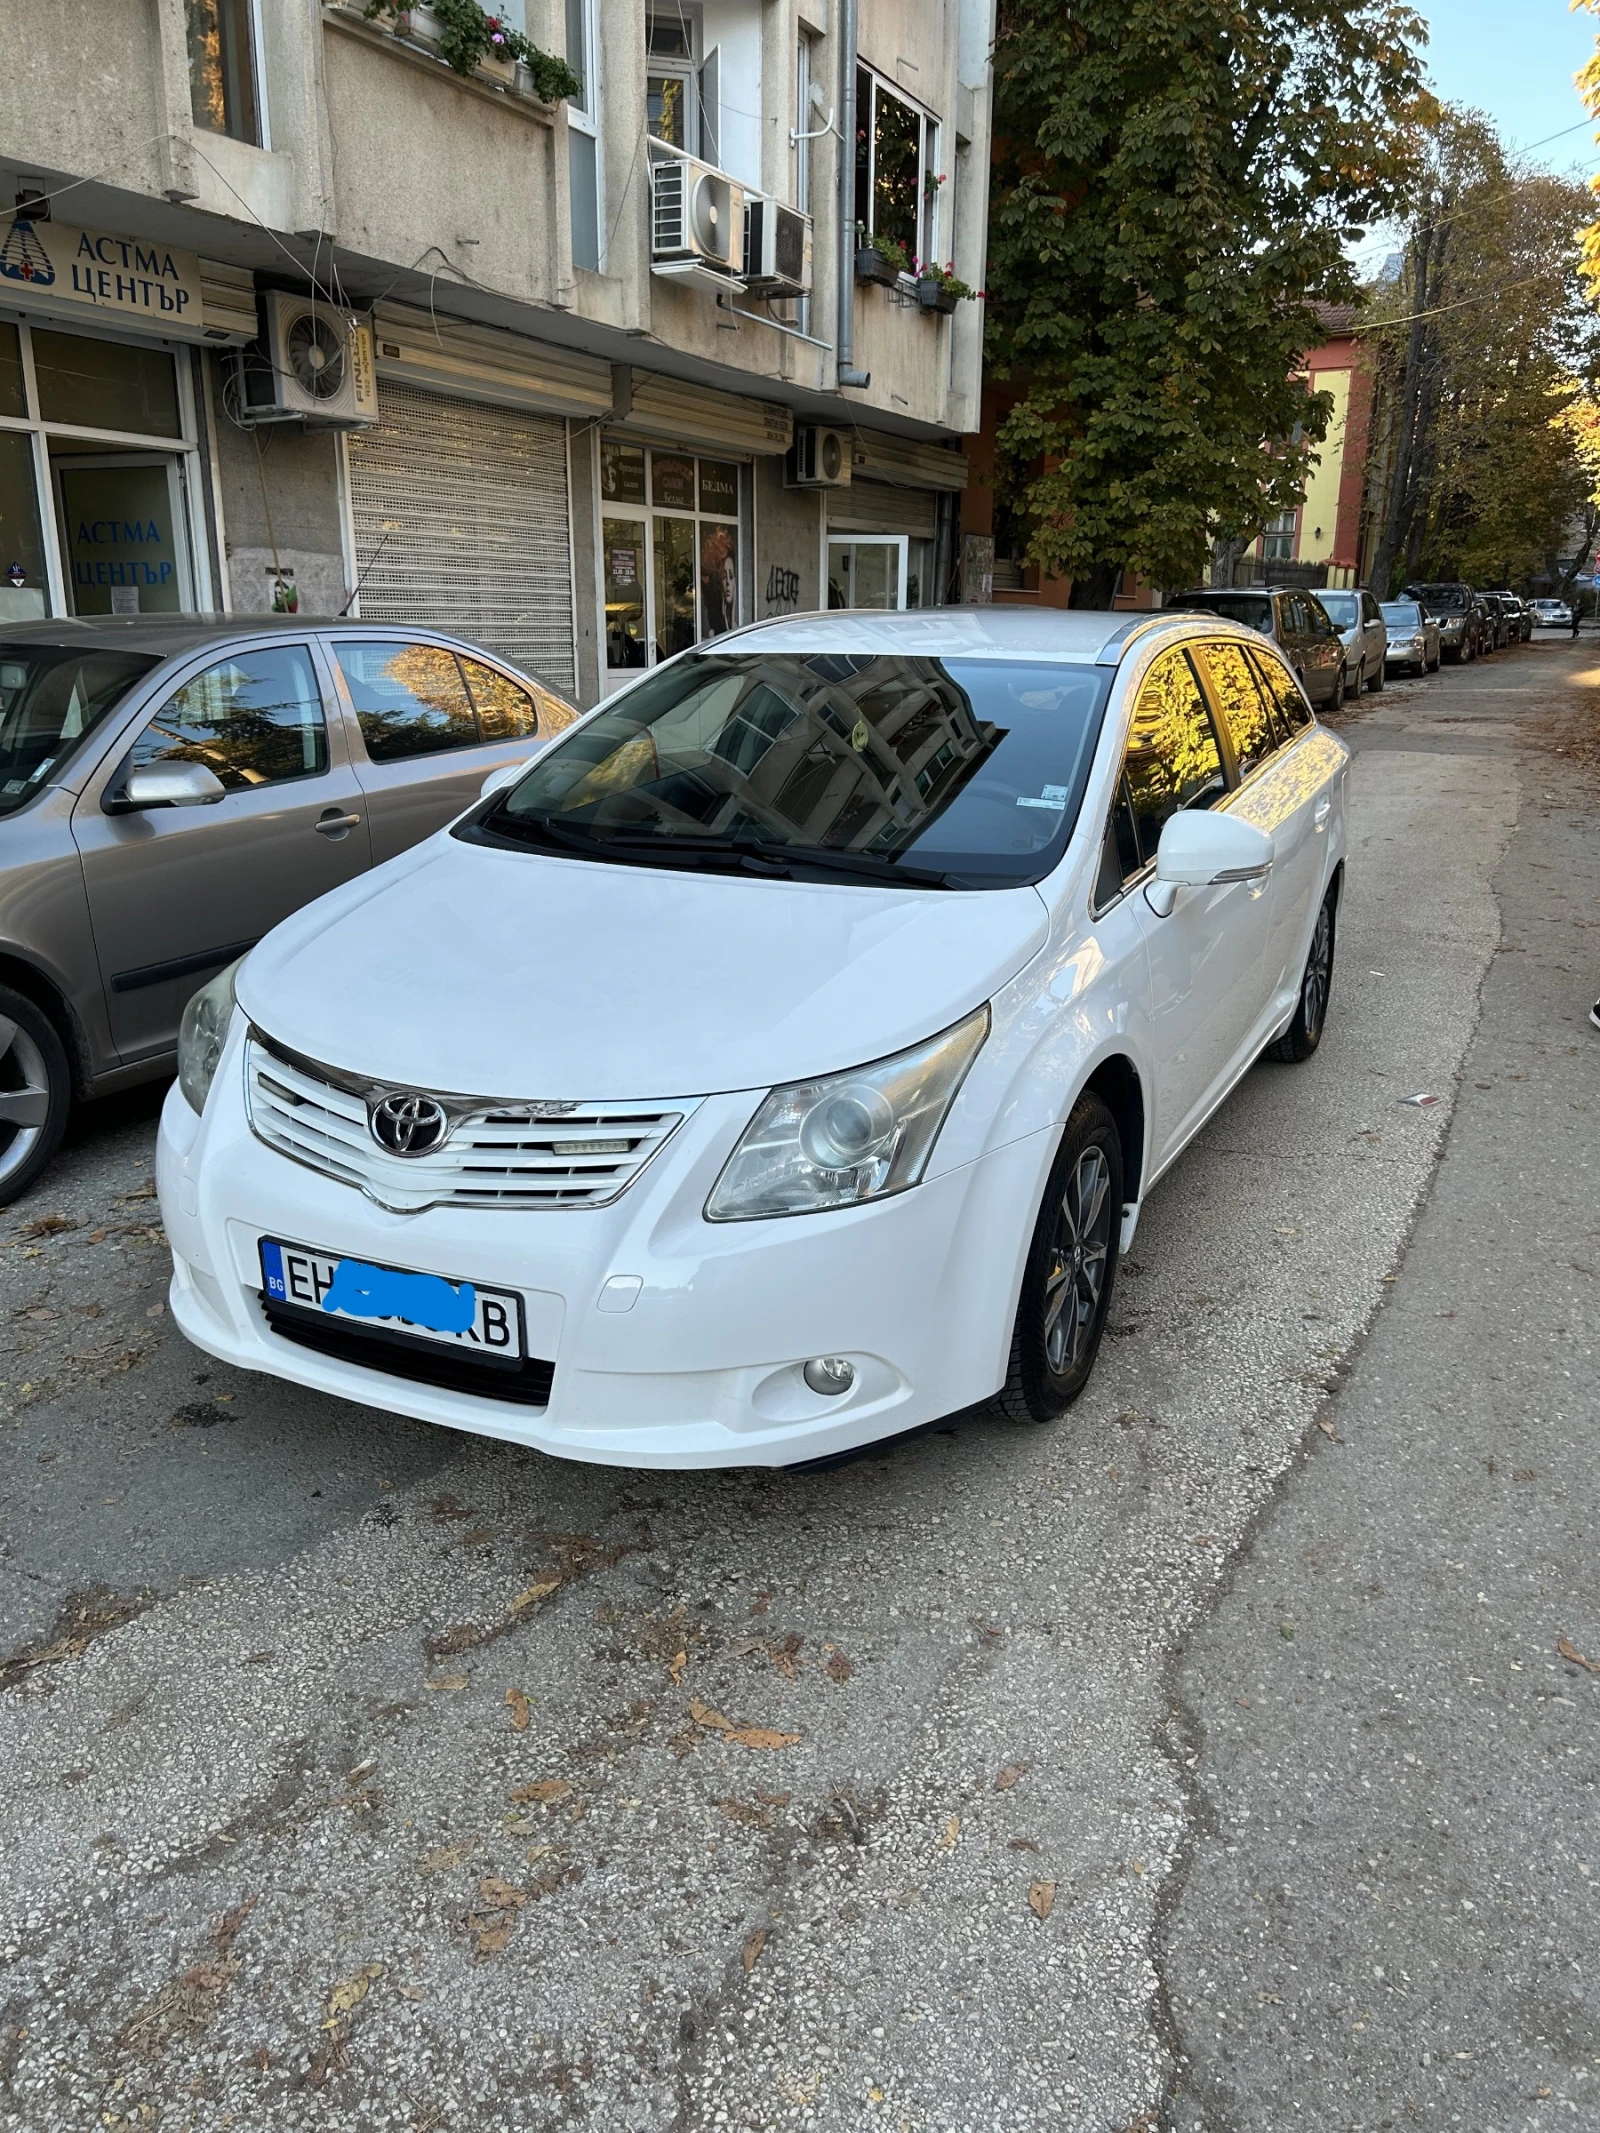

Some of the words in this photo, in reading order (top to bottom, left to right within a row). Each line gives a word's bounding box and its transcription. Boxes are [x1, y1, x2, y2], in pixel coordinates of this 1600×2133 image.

[77, 232, 179, 281] АСТМА
[72, 264, 190, 314] ЦЕНТЪР
[77, 520, 160, 544] АСТМА
[76, 562, 172, 591] ЦЕНТЪР
[268, 1275, 285, 1292] BG
